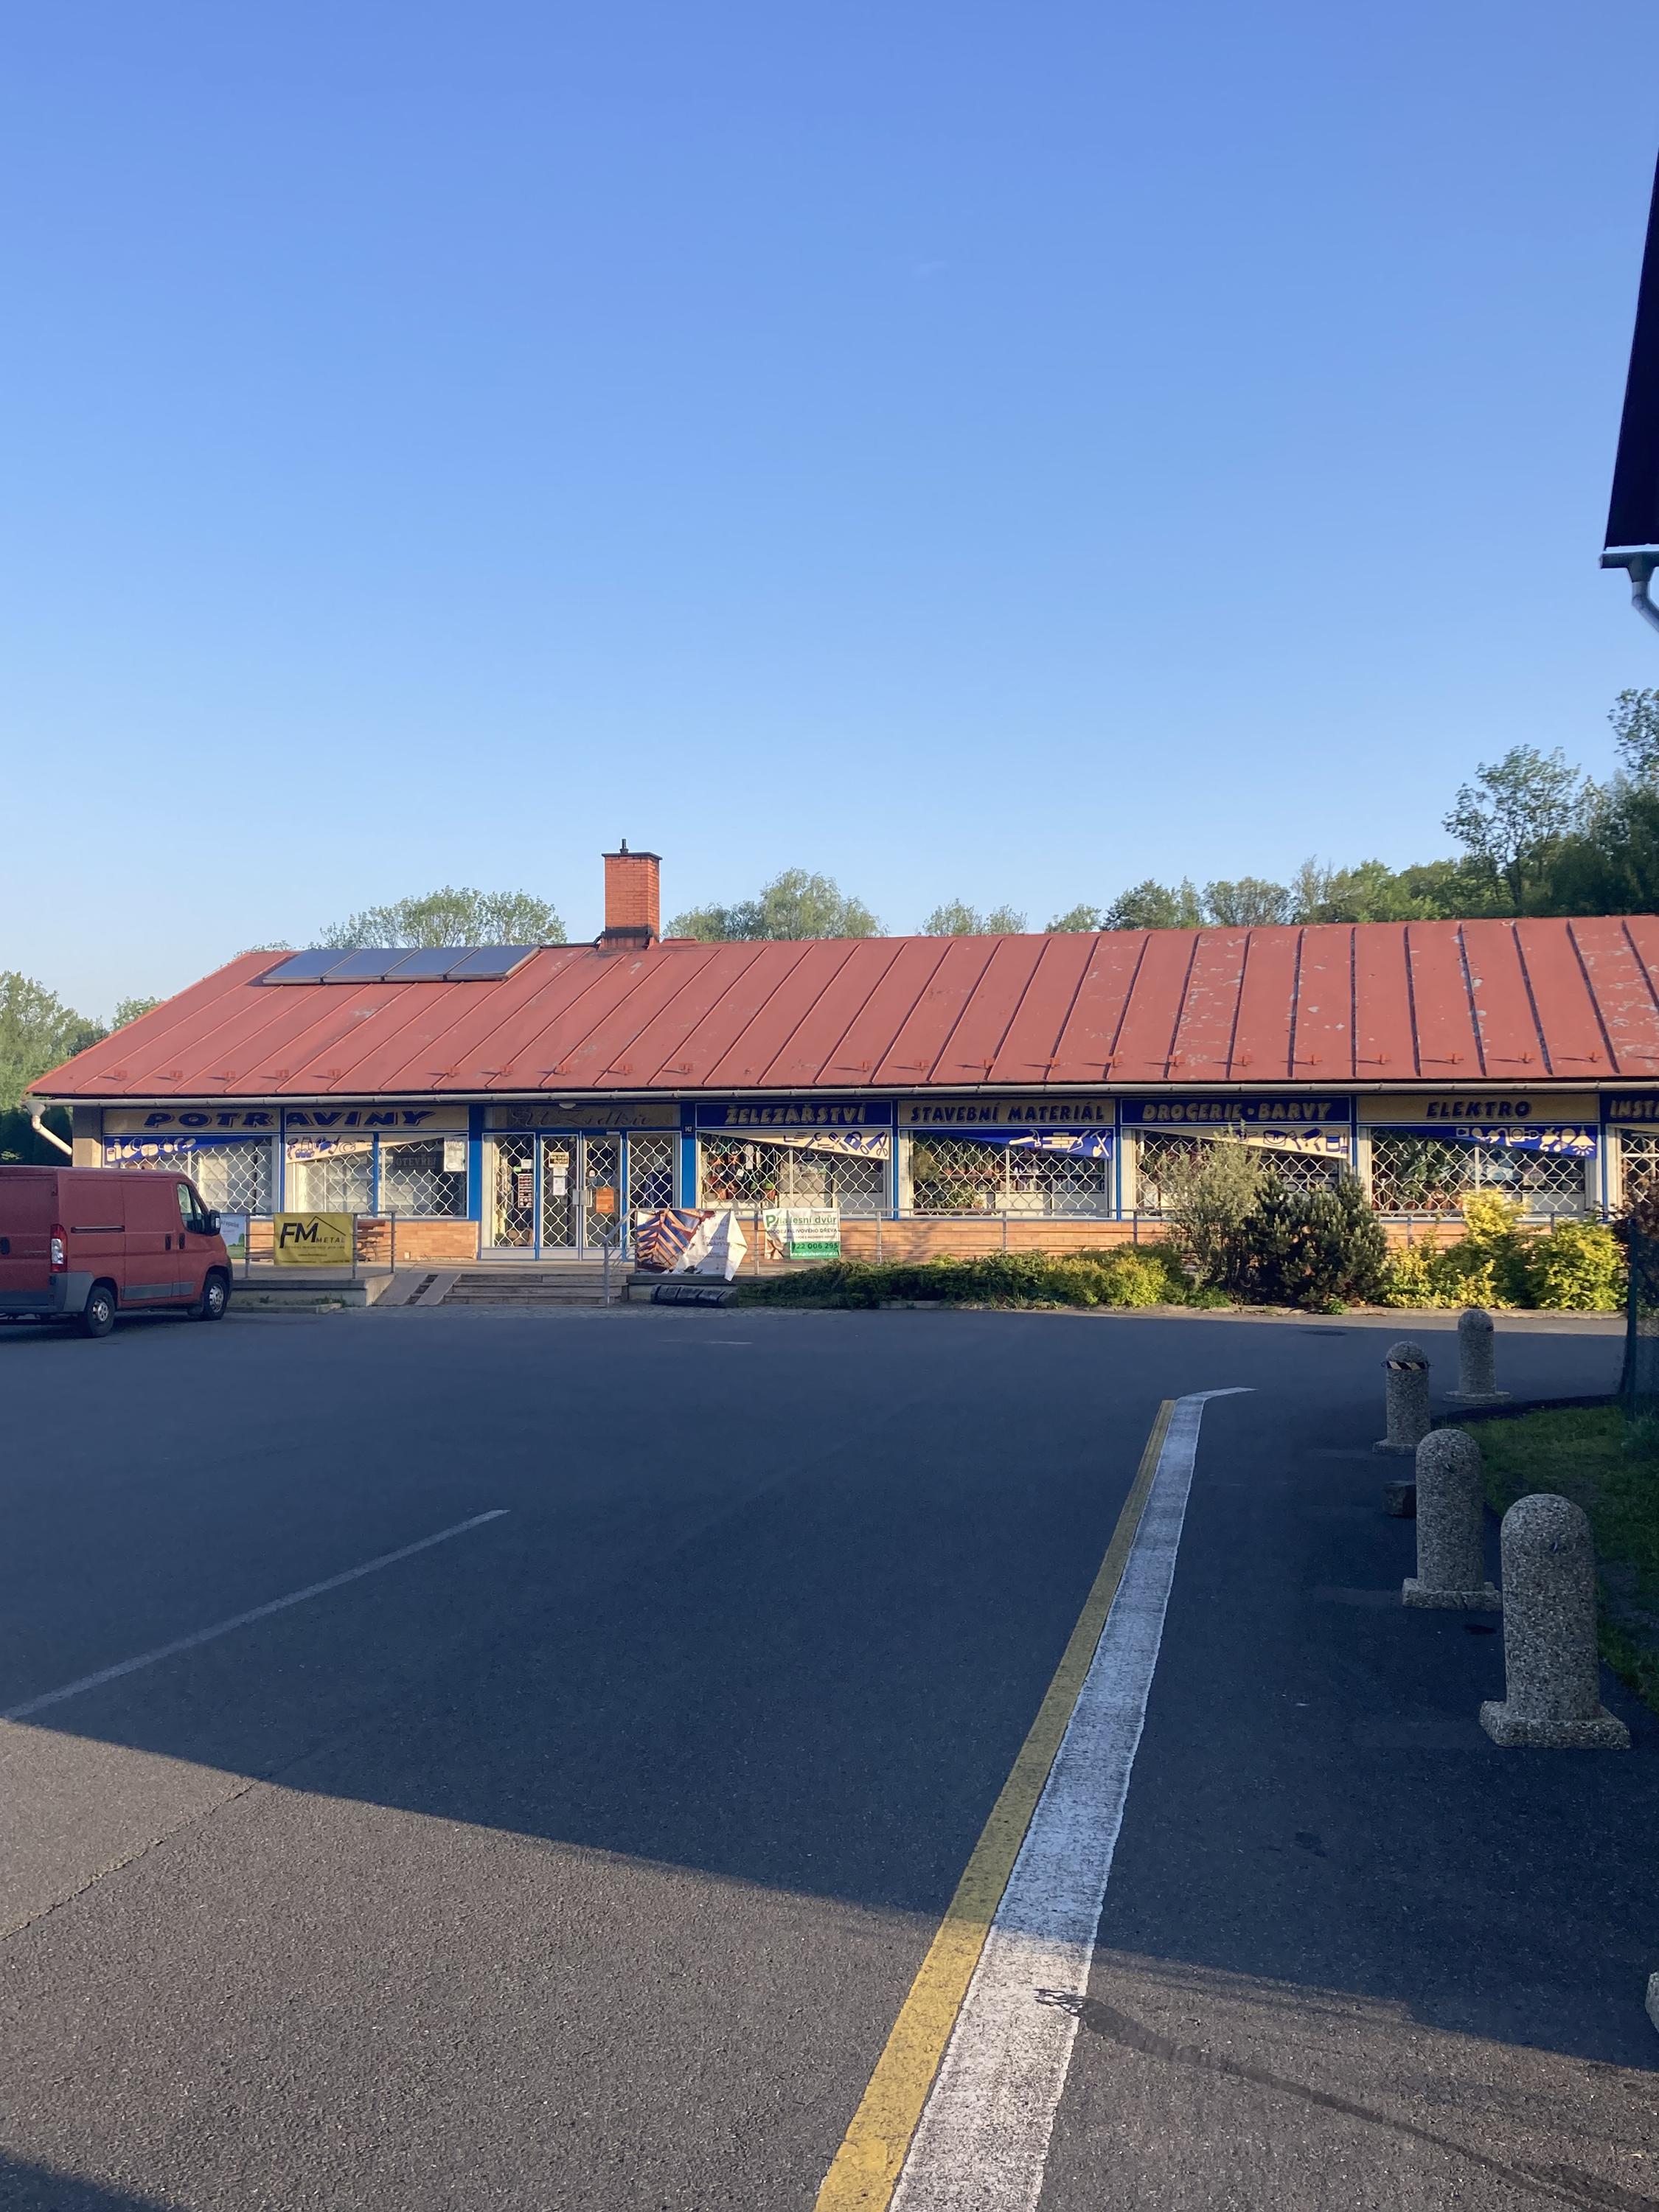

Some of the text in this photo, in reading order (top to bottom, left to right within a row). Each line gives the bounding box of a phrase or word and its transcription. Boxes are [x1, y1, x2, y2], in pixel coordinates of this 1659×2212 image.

[144, 1110, 435, 1127] POTRAVINY
[725, 1104, 866, 1125] ŽELEZÁŘSTVÍ
[911, 1102, 1105, 1123] STAVEBNÍ MATERIÁL
[1142, 1102, 1332, 1121] DROGERIE BARVY
[1426, 1101, 1532, 1119] ELEKTRO
[815, 1215, 837, 1223] dvůr
[279, 1222, 319, 1248] FM
